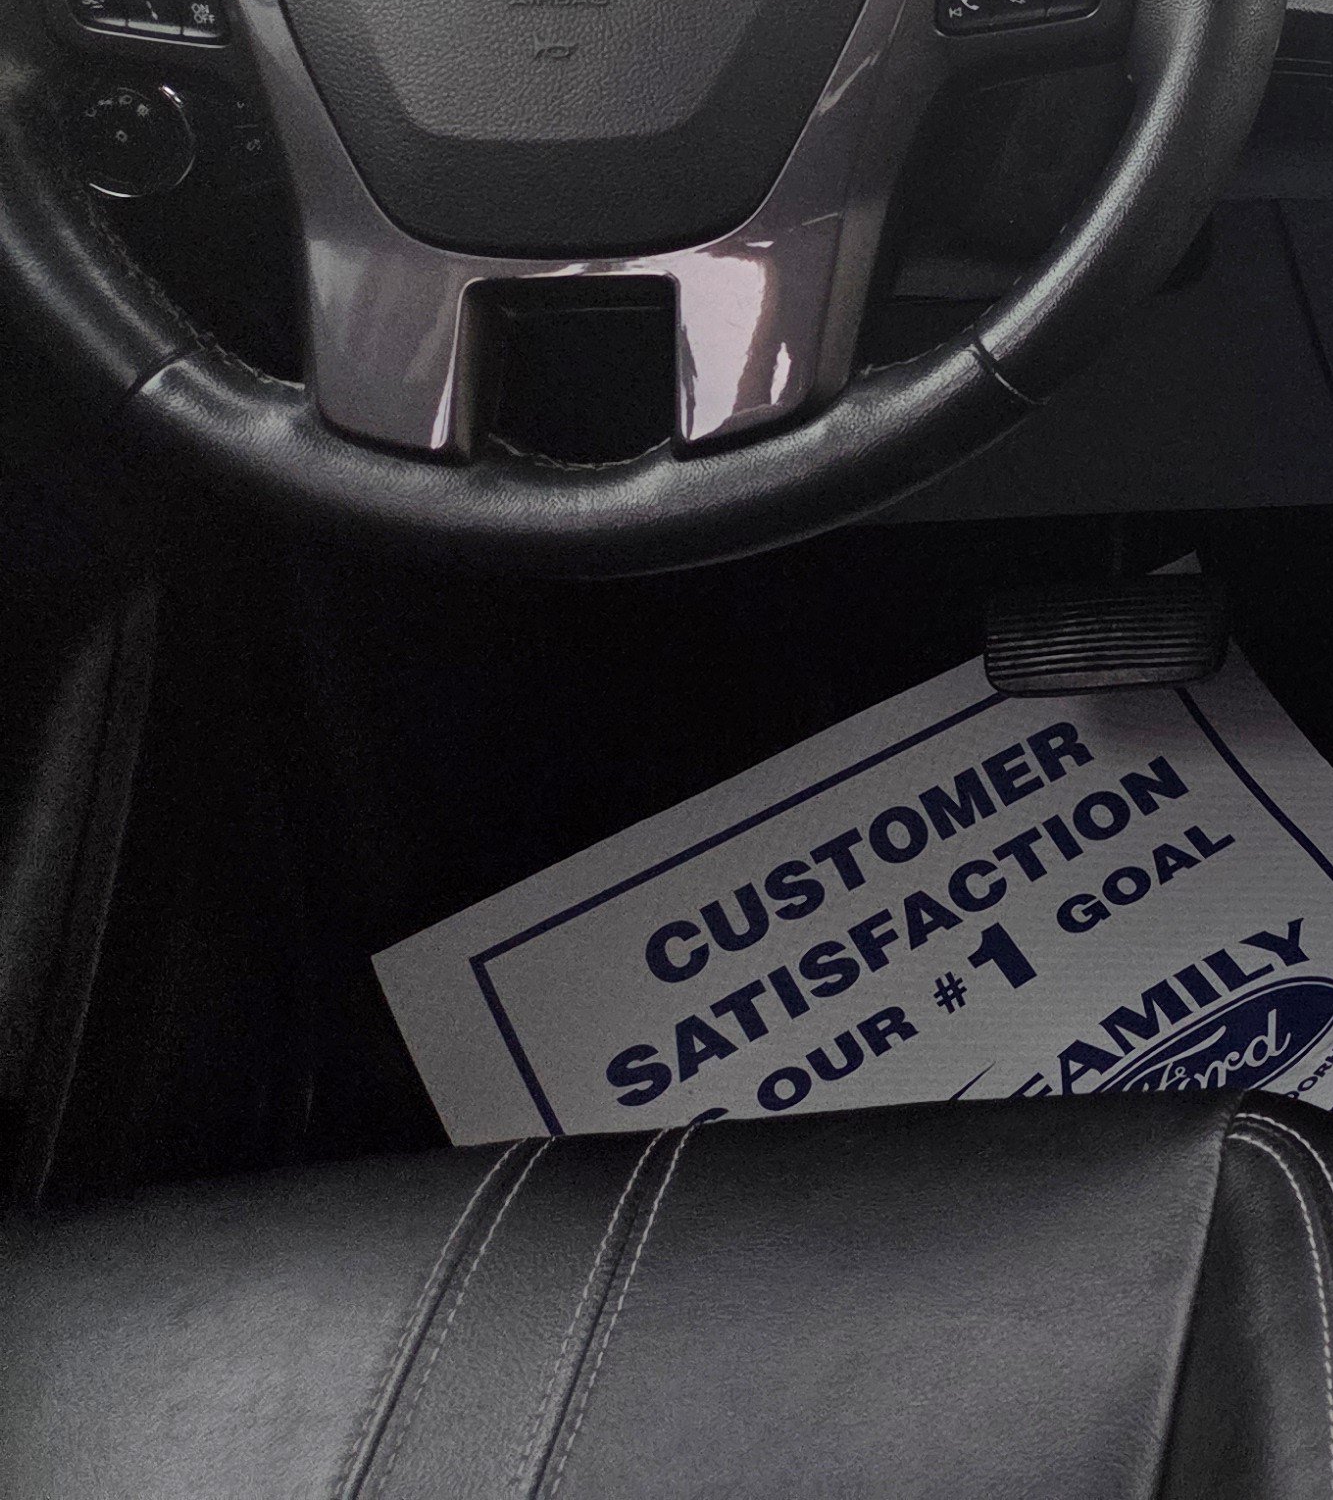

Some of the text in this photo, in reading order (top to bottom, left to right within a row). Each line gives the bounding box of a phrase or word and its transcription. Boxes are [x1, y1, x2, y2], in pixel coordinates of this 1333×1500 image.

[604, 755, 1190, 1106] SATISFACTION
[643, 719, 1094, 985] CUSTOMER
[755, 1007, 919, 1114] OUR
[1055, 824, 1236, 934] GOAL
